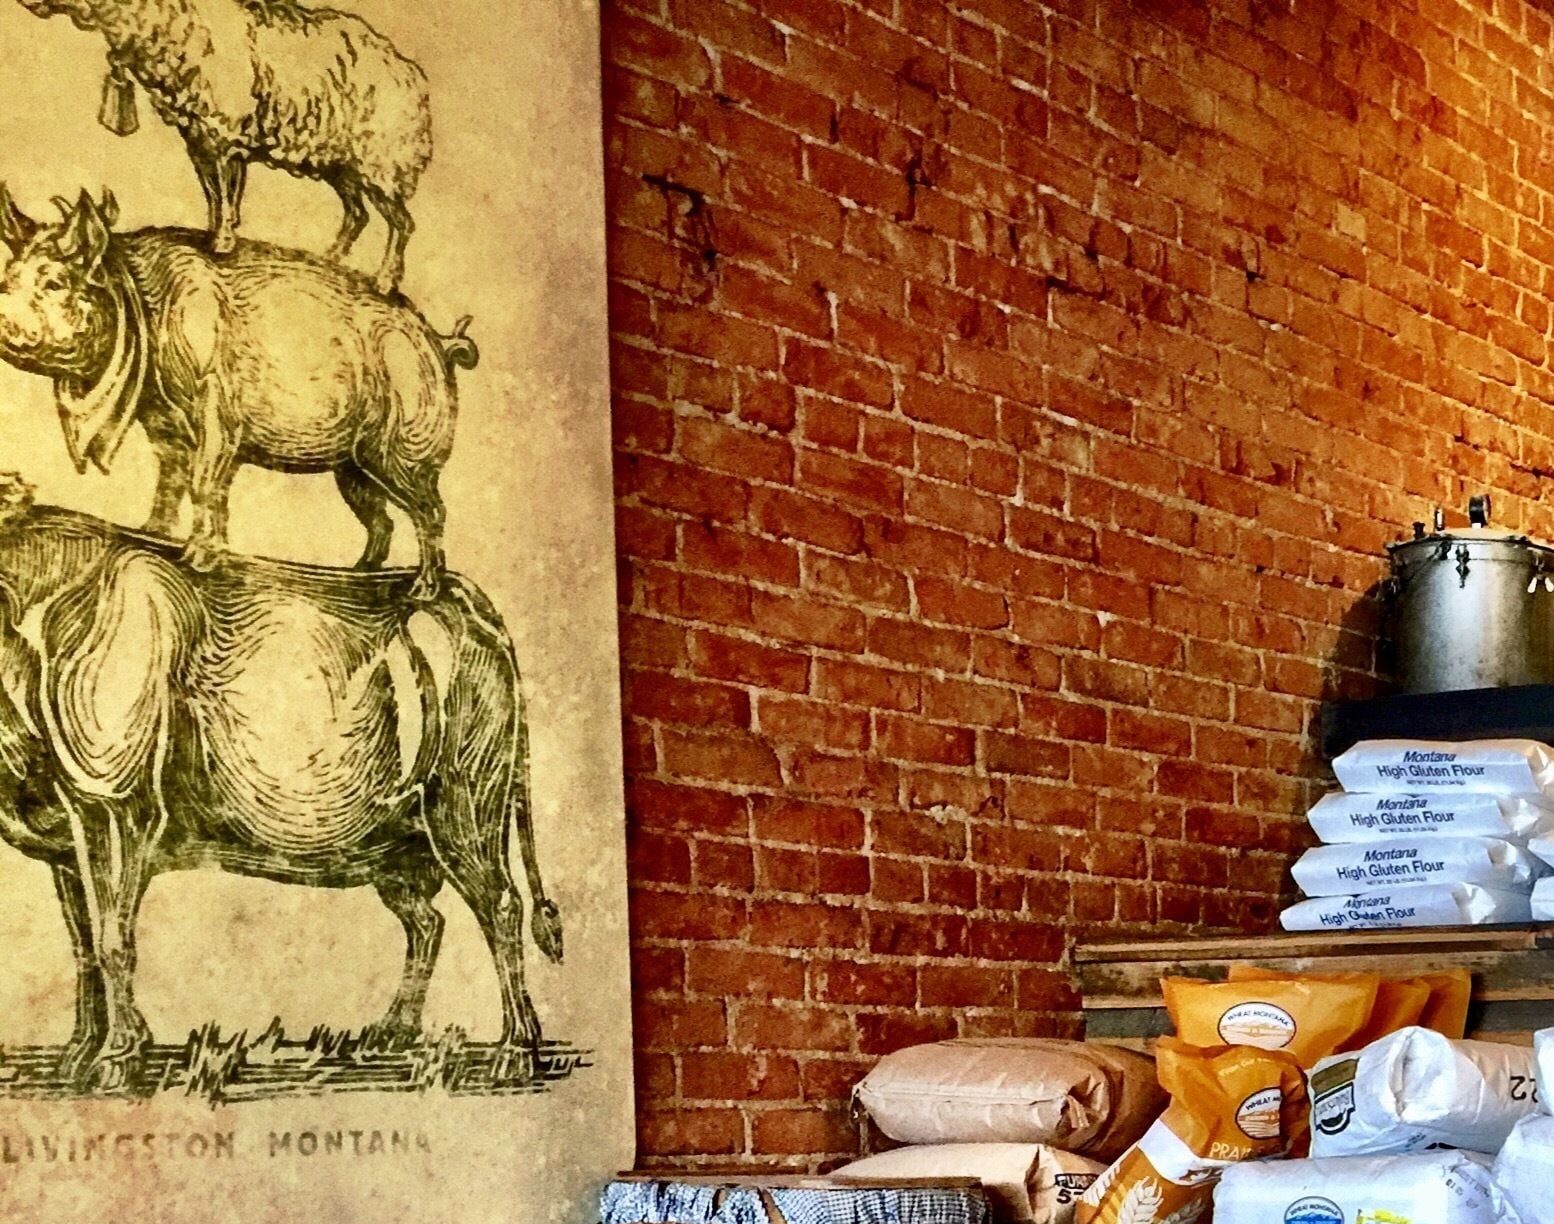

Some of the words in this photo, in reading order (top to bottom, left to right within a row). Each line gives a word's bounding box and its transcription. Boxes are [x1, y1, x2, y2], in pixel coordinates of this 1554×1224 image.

[1403, 751, 1456, 763] Montana
[1377, 766, 1405, 778] High
[1409, 765, 1450, 777] Gluten
[1453, 765, 1485, 776] Flour
[1376, 799, 1428, 811] Montana
[1351, 815, 1379, 828] High
[1382, 812, 1421, 825] Gluten
[1424, 811, 1455, 822] Flour
[1364, 849, 1417, 862] Montana
[1337, 866, 1367, 880] High
[1370, 863, 1409, 877] Gluten
[1413, 861, 1445, 873] Flour
[1320, 914, 1348, 927] High
[1387, 907, 1416, 920] Flour
[1245, 1096, 1271, 1110] WHEAT
[3, 1131, 235, 1163] LIVINGSTON
[269, 1130, 432, 1157] MONTANA
